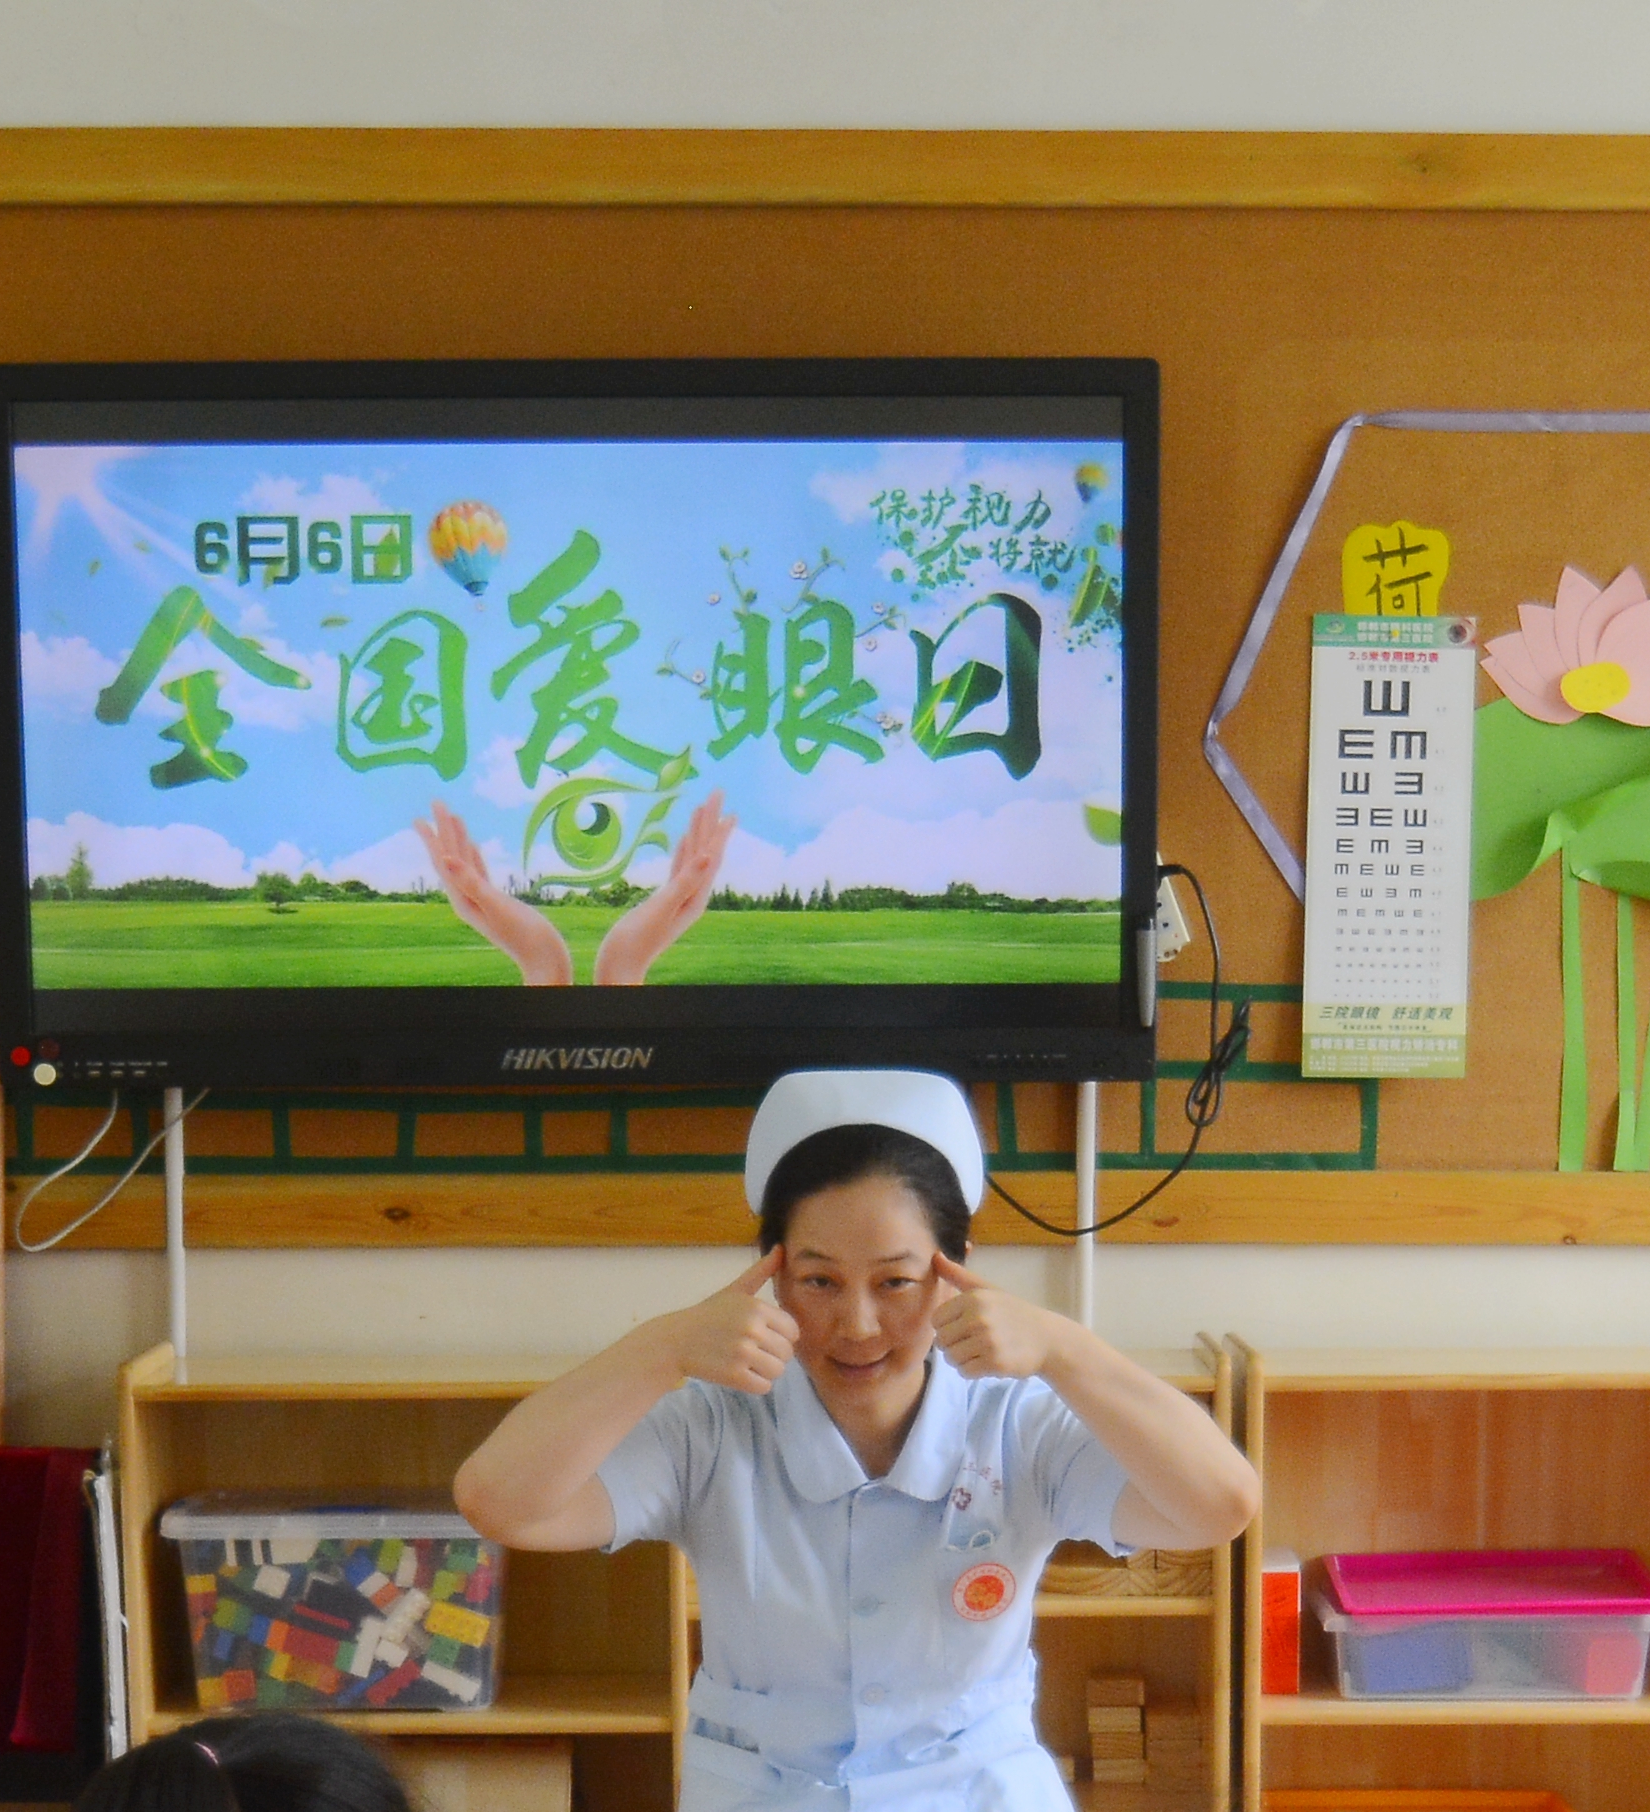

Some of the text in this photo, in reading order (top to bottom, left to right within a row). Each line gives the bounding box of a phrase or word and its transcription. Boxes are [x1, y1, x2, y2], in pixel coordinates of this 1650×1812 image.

[869, 483, 1051, 534] 保护视力
[195, 514, 412, 588] 6月6日
[1362, 526, 1433, 616] 荷
[93, 530, 1043, 790] 全国爱眼日
[501, 1047, 653, 1070] HIKVISION
